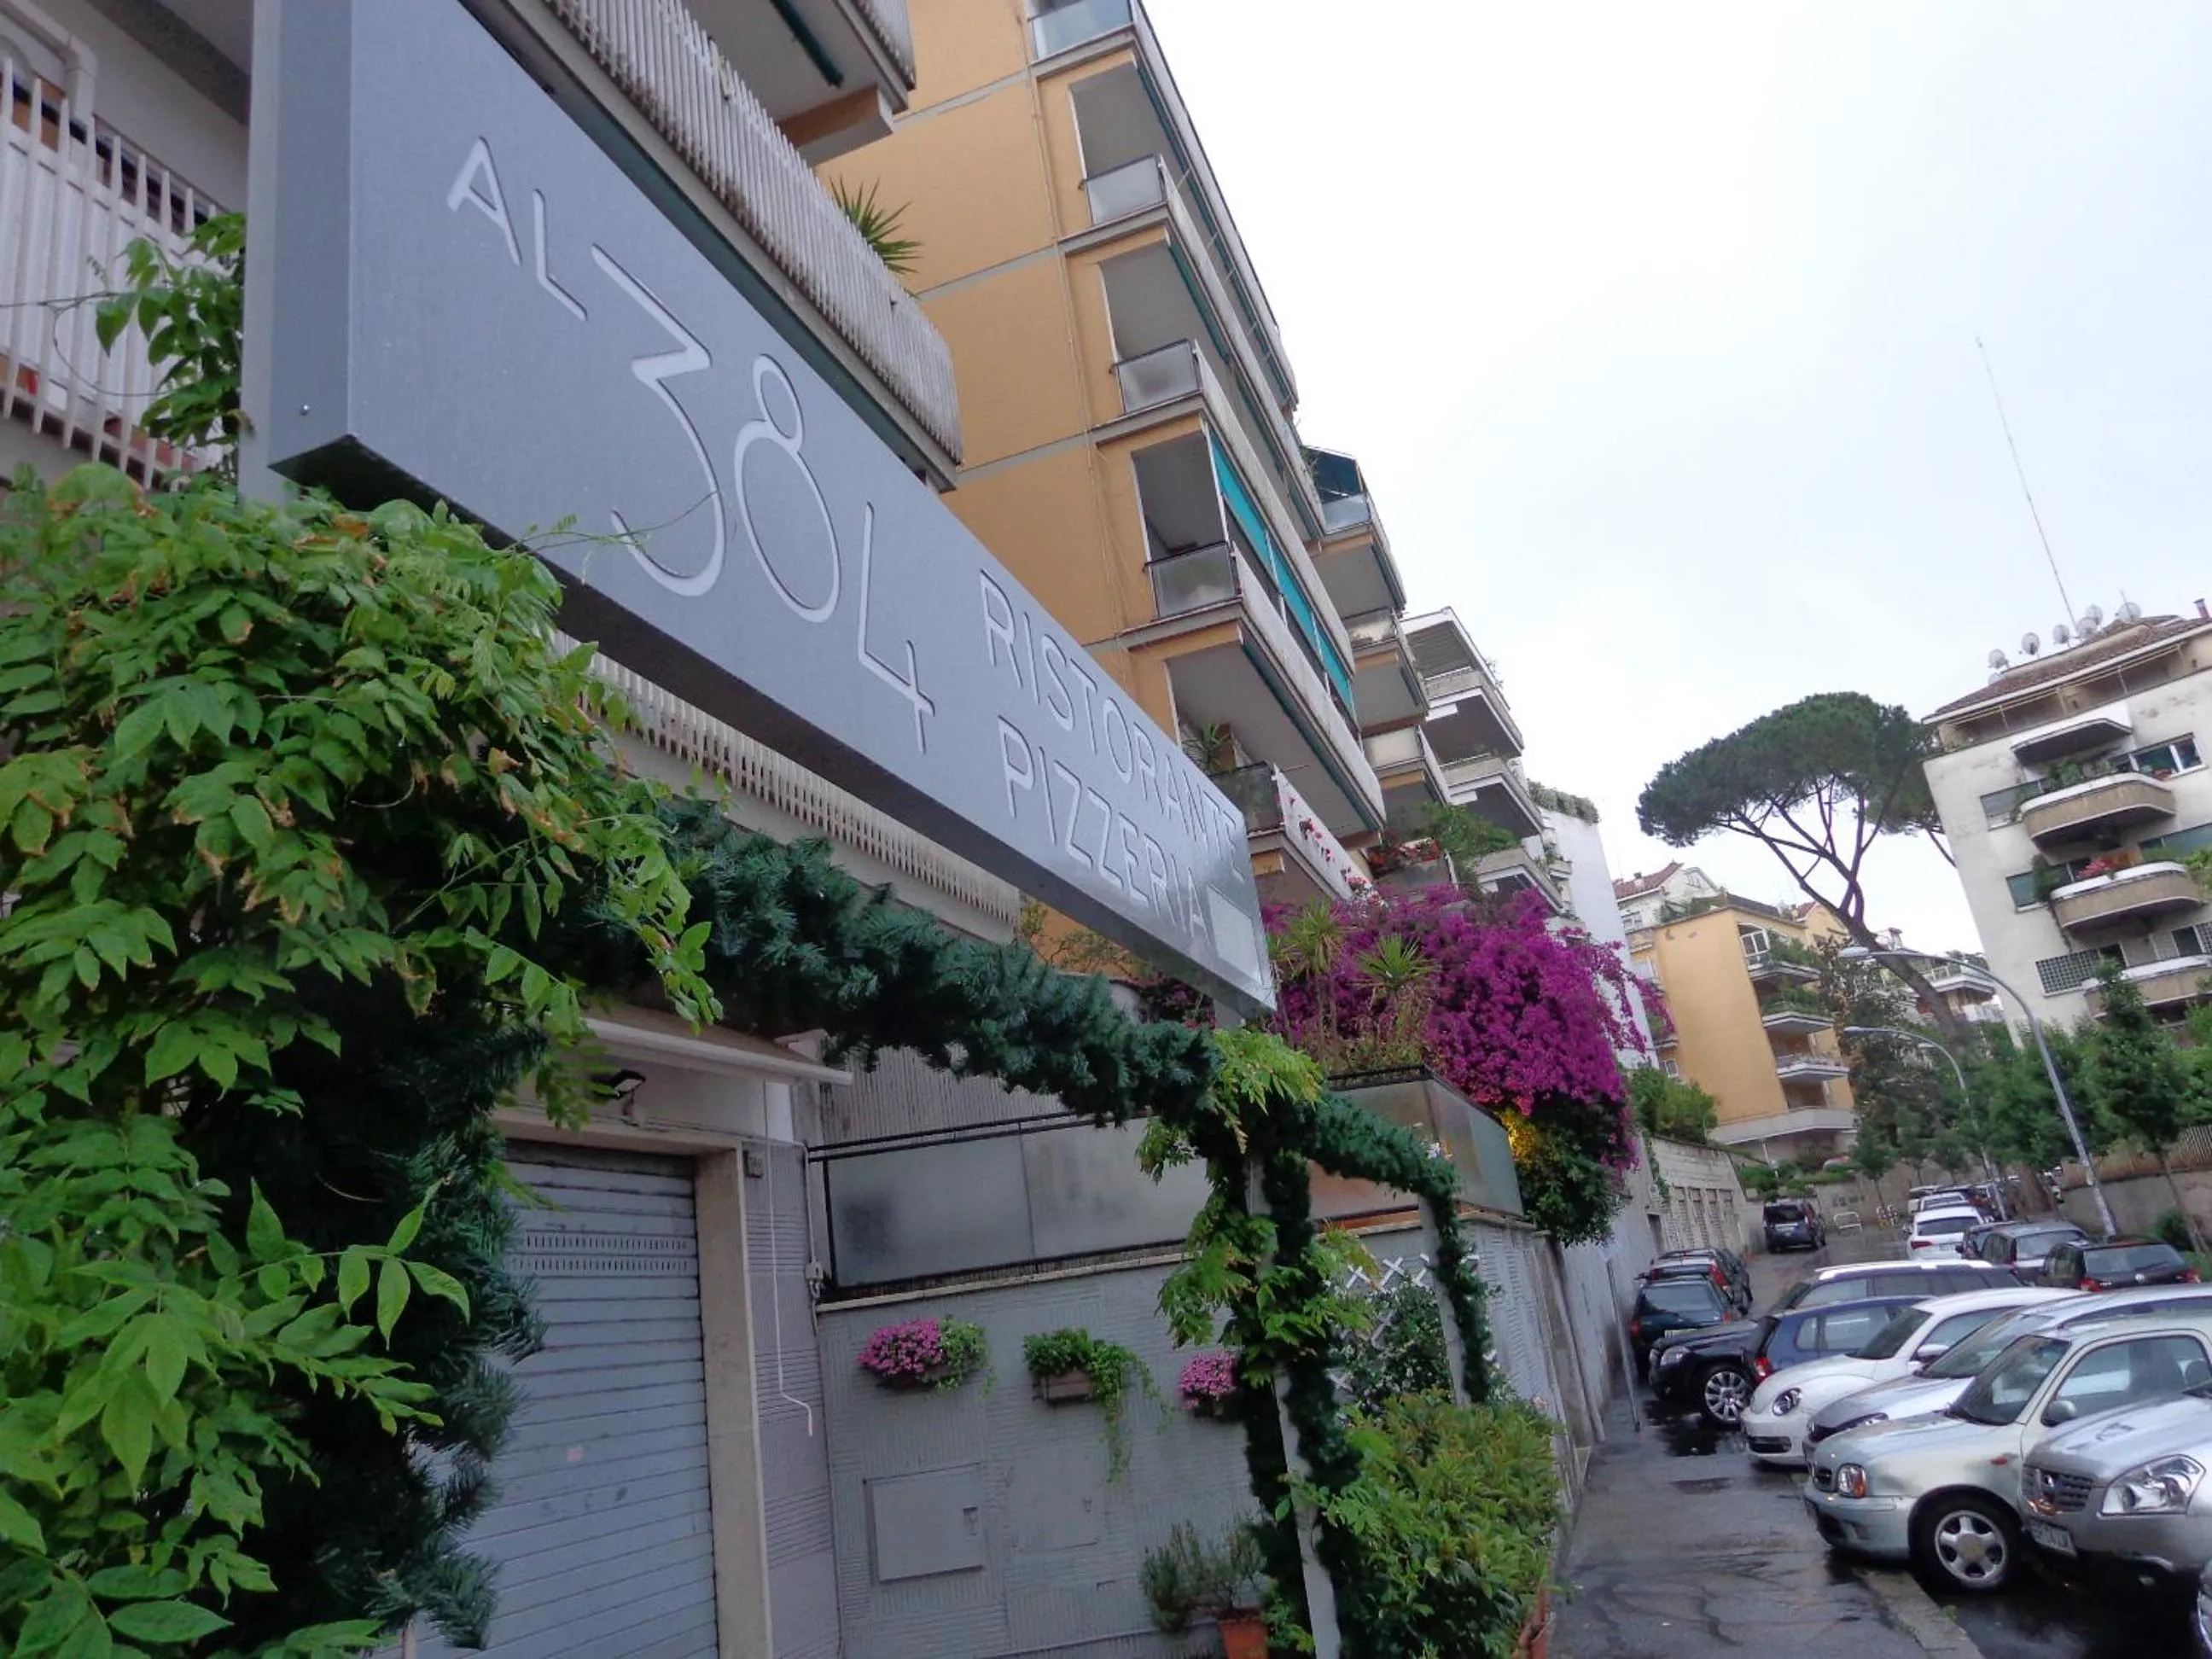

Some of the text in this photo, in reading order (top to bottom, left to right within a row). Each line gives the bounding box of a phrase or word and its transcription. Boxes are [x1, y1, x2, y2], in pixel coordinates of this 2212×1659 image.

[447, 135, 936, 754] AL 384
[980, 568, 1247, 882] RISTORANTE
[998, 714, 1210, 945] PIZZERIA
